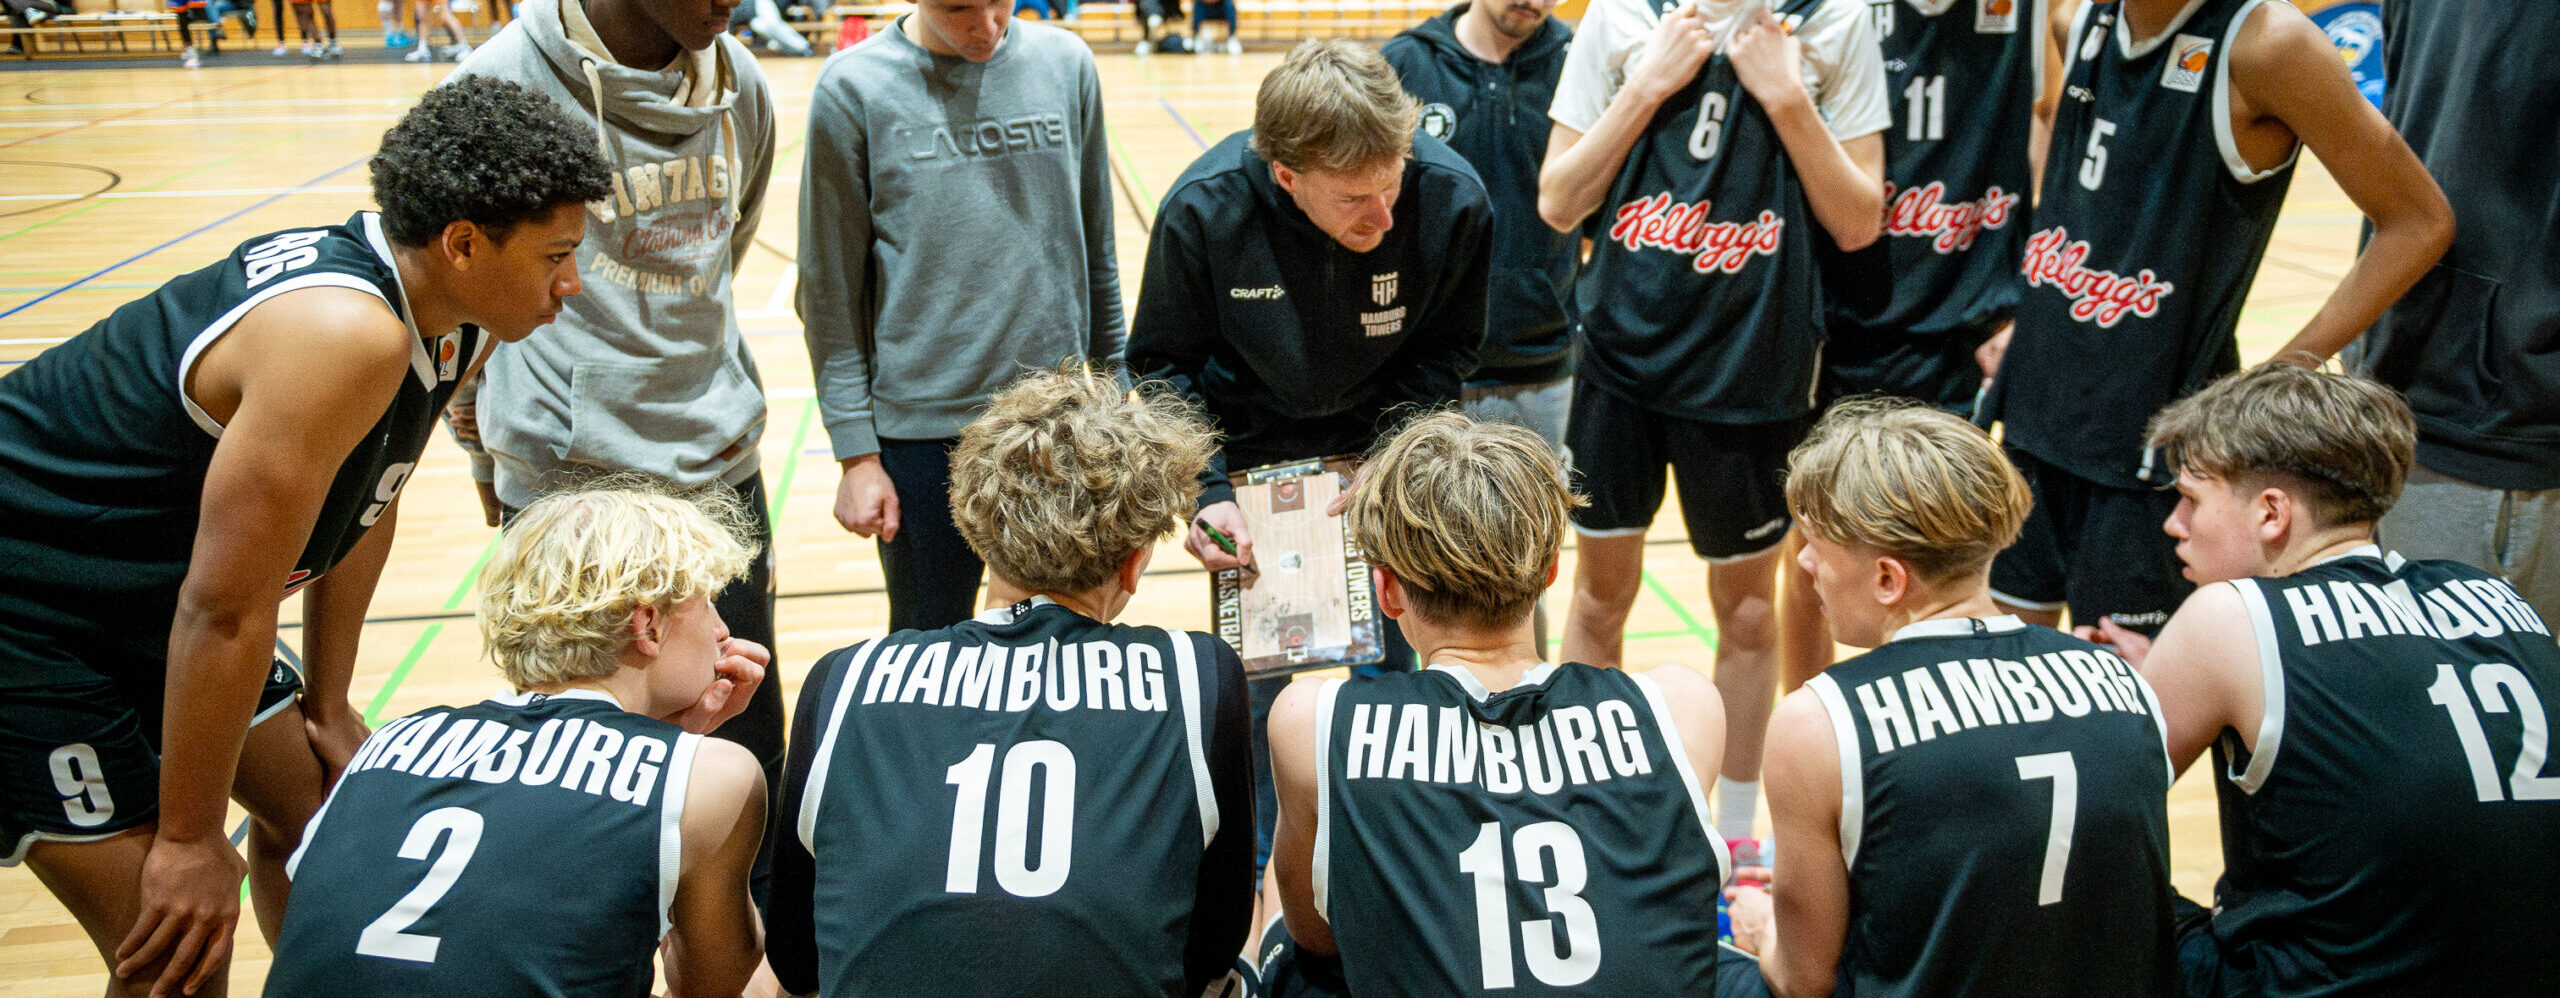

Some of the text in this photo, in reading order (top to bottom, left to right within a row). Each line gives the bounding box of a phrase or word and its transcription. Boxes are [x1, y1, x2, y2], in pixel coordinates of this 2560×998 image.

[905, 113, 1064, 161] LACOSTE
[1688, 91, 1728, 161] 6
[1903, 75, 1945, 141] 11
[584, 154, 742, 225] INTAG
[2079, 117, 2117, 192] 5
[1609, 190, 1785, 275] Kellogg's
[590, 251, 683, 296] PREMIUM
[1230, 287, 1275, 300] CRAFT
[2020, 225, 2174, 329] Kellogg's
[1360, 306, 1407, 325] HAMBURG
[1365, 319, 1402, 338] TOWERS
[1346, 561, 1373, 622] TOWERS
[2282, 579, 2552, 646] HAMBURG
[862, 639, 1169, 712] HAMBURG
[1857, 649, 2148, 753] HAMBURG
[349, 711, 668, 807] HAMBURG
[1346, 699, 1653, 795] HAMBURG
[2428, 663, 2560, 801] 12
[49, 742, 116, 828] 9
[945, 739, 1076, 898] 10
[2015, 751, 2079, 907] 7
[355, 806, 485, 963] 2
[1459, 820, 1602, 990] 13
